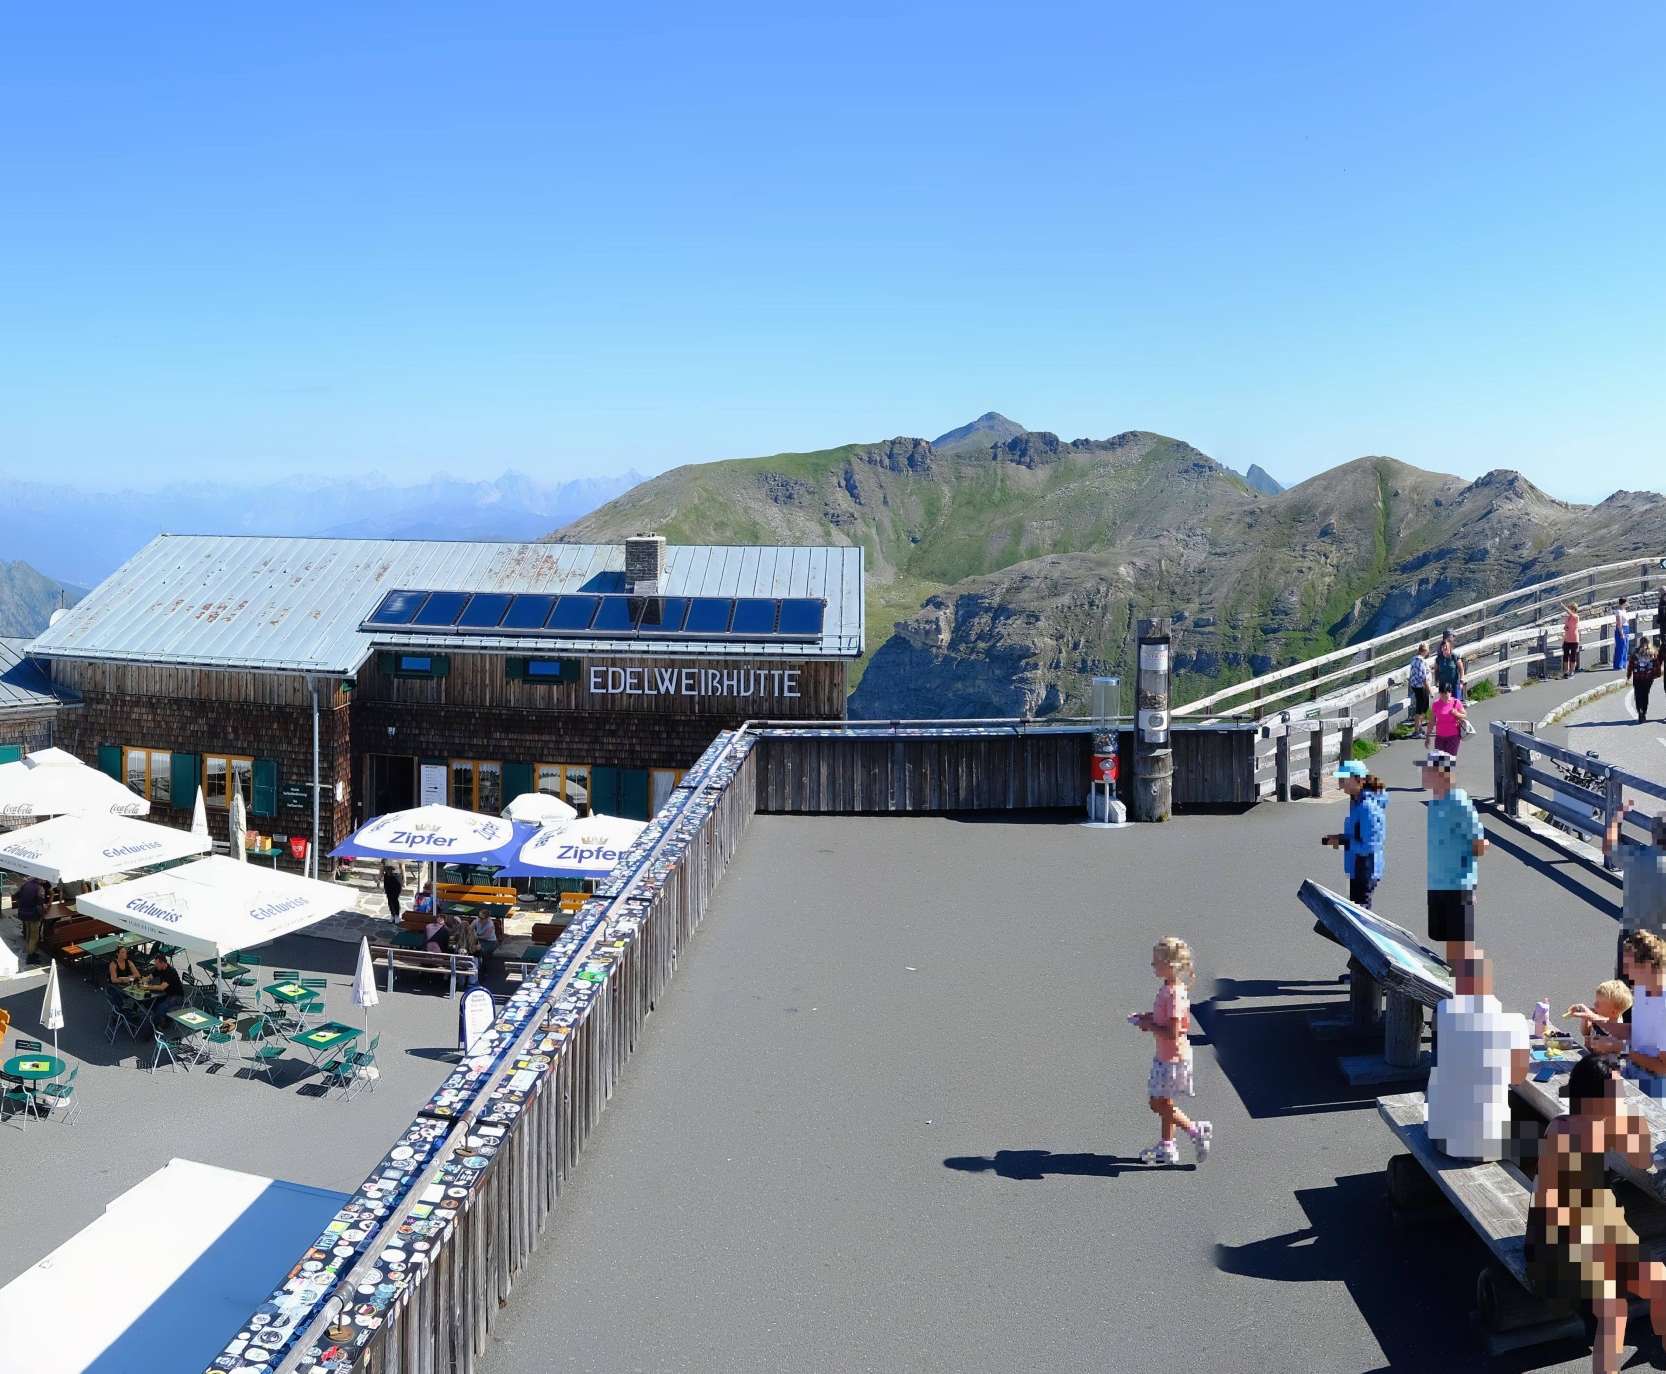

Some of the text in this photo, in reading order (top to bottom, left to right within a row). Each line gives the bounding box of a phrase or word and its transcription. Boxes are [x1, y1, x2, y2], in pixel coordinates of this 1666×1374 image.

[589, 665, 802, 697] EDELWEIßHÜTTE
[102, 841, 162, 859] Edelweiss
[389, 831, 458, 848] Zipfer
[556, 845, 628, 863] Zipfer
[125, 897, 183, 923] Edelweiss
[249, 895, 310, 921] Edelweiss
